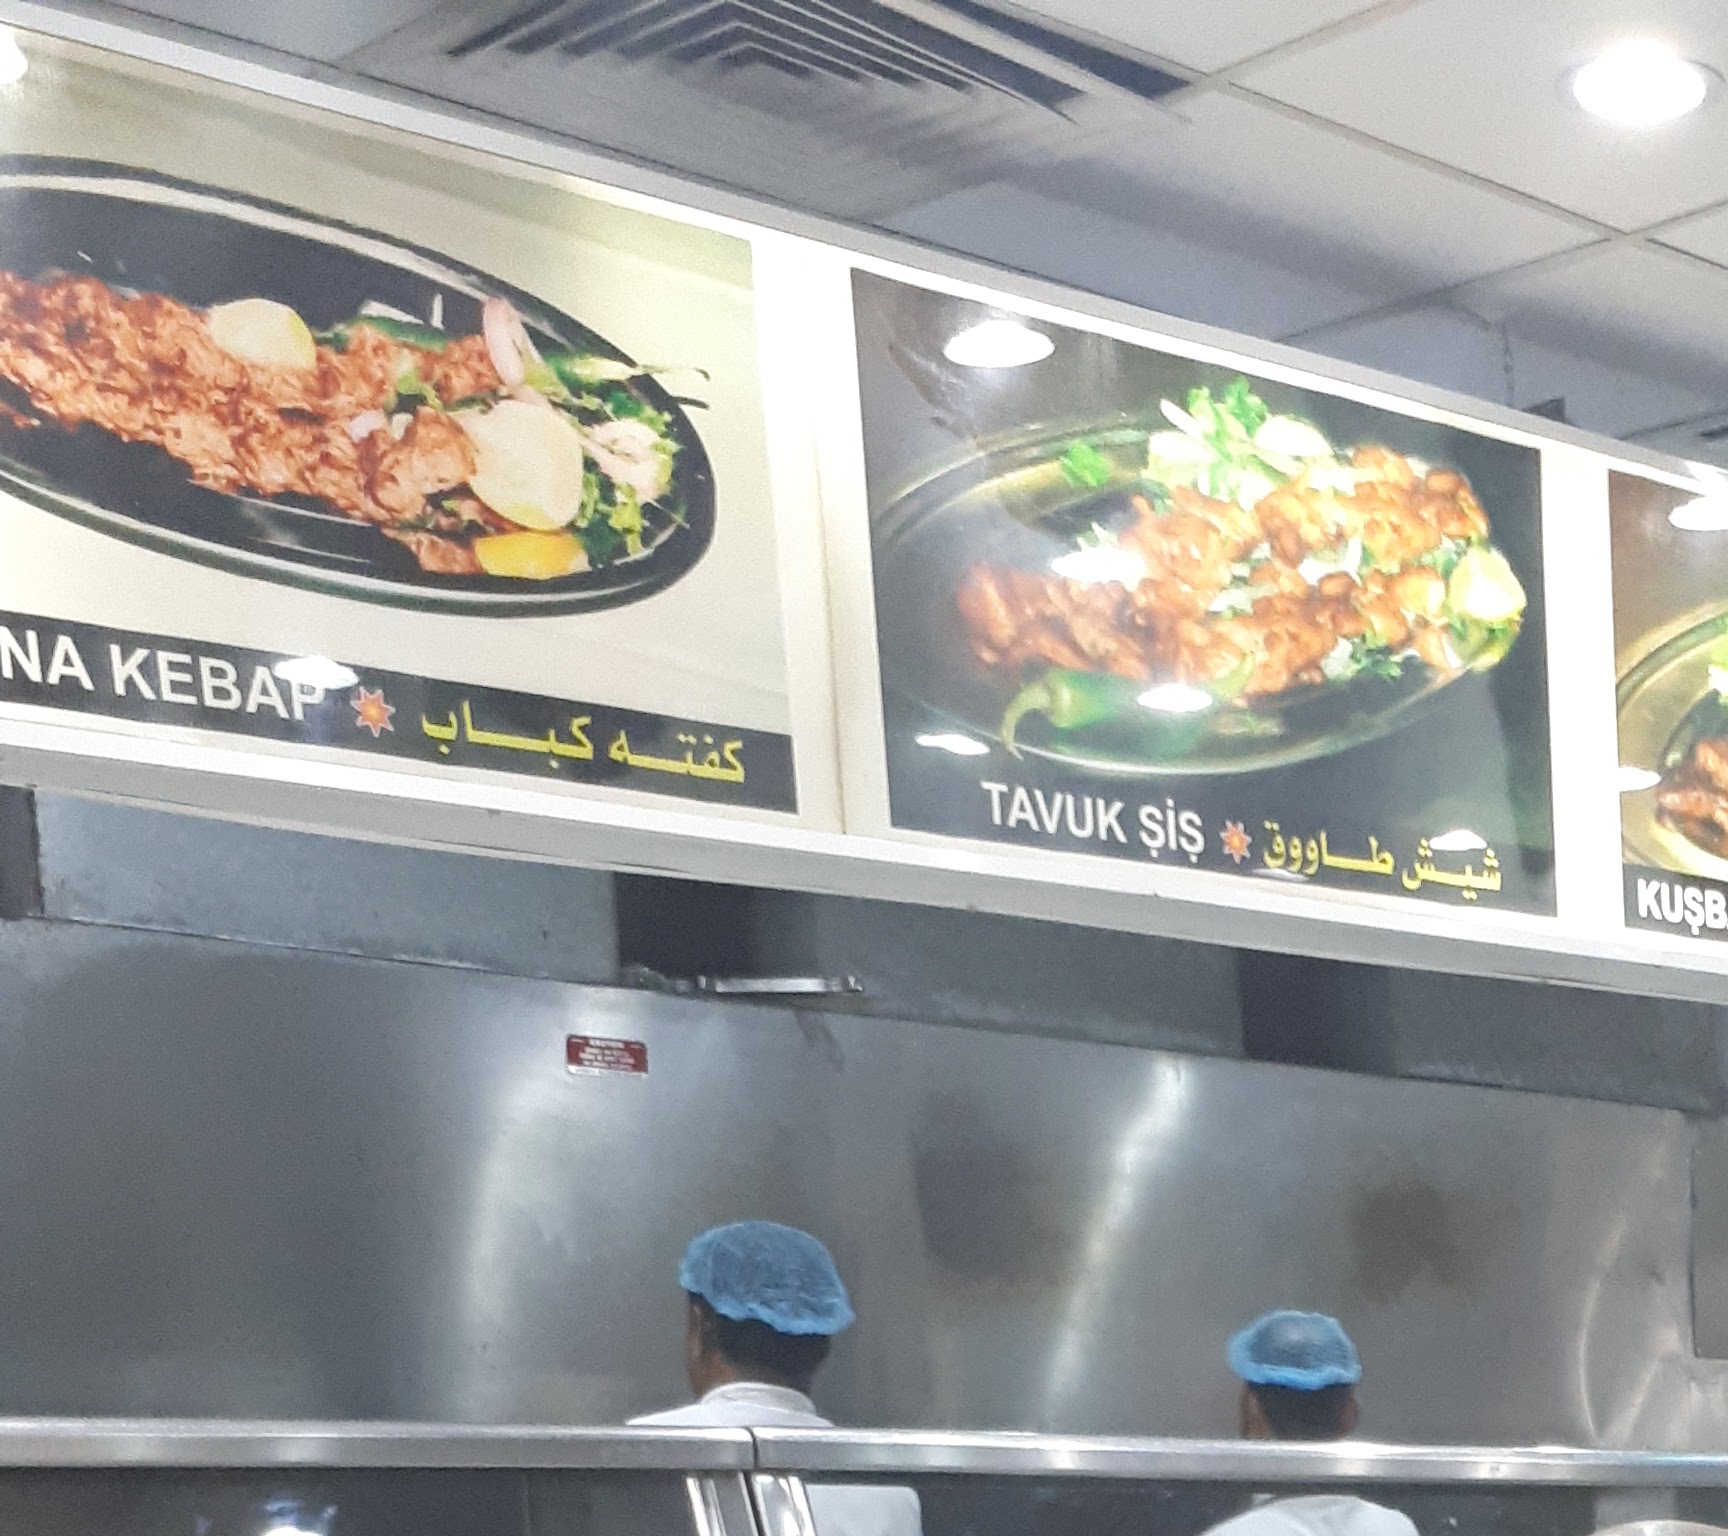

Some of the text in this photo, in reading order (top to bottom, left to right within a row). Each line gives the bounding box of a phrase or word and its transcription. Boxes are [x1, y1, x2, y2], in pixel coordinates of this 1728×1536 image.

[109, 643, 325, 721] KEBAP
[421, 700, 594, 769] كباب
[981, 780, 1205, 864] TAVUK ŞİŞ
[1263, 819, 1502, 901] شيش طاووق
